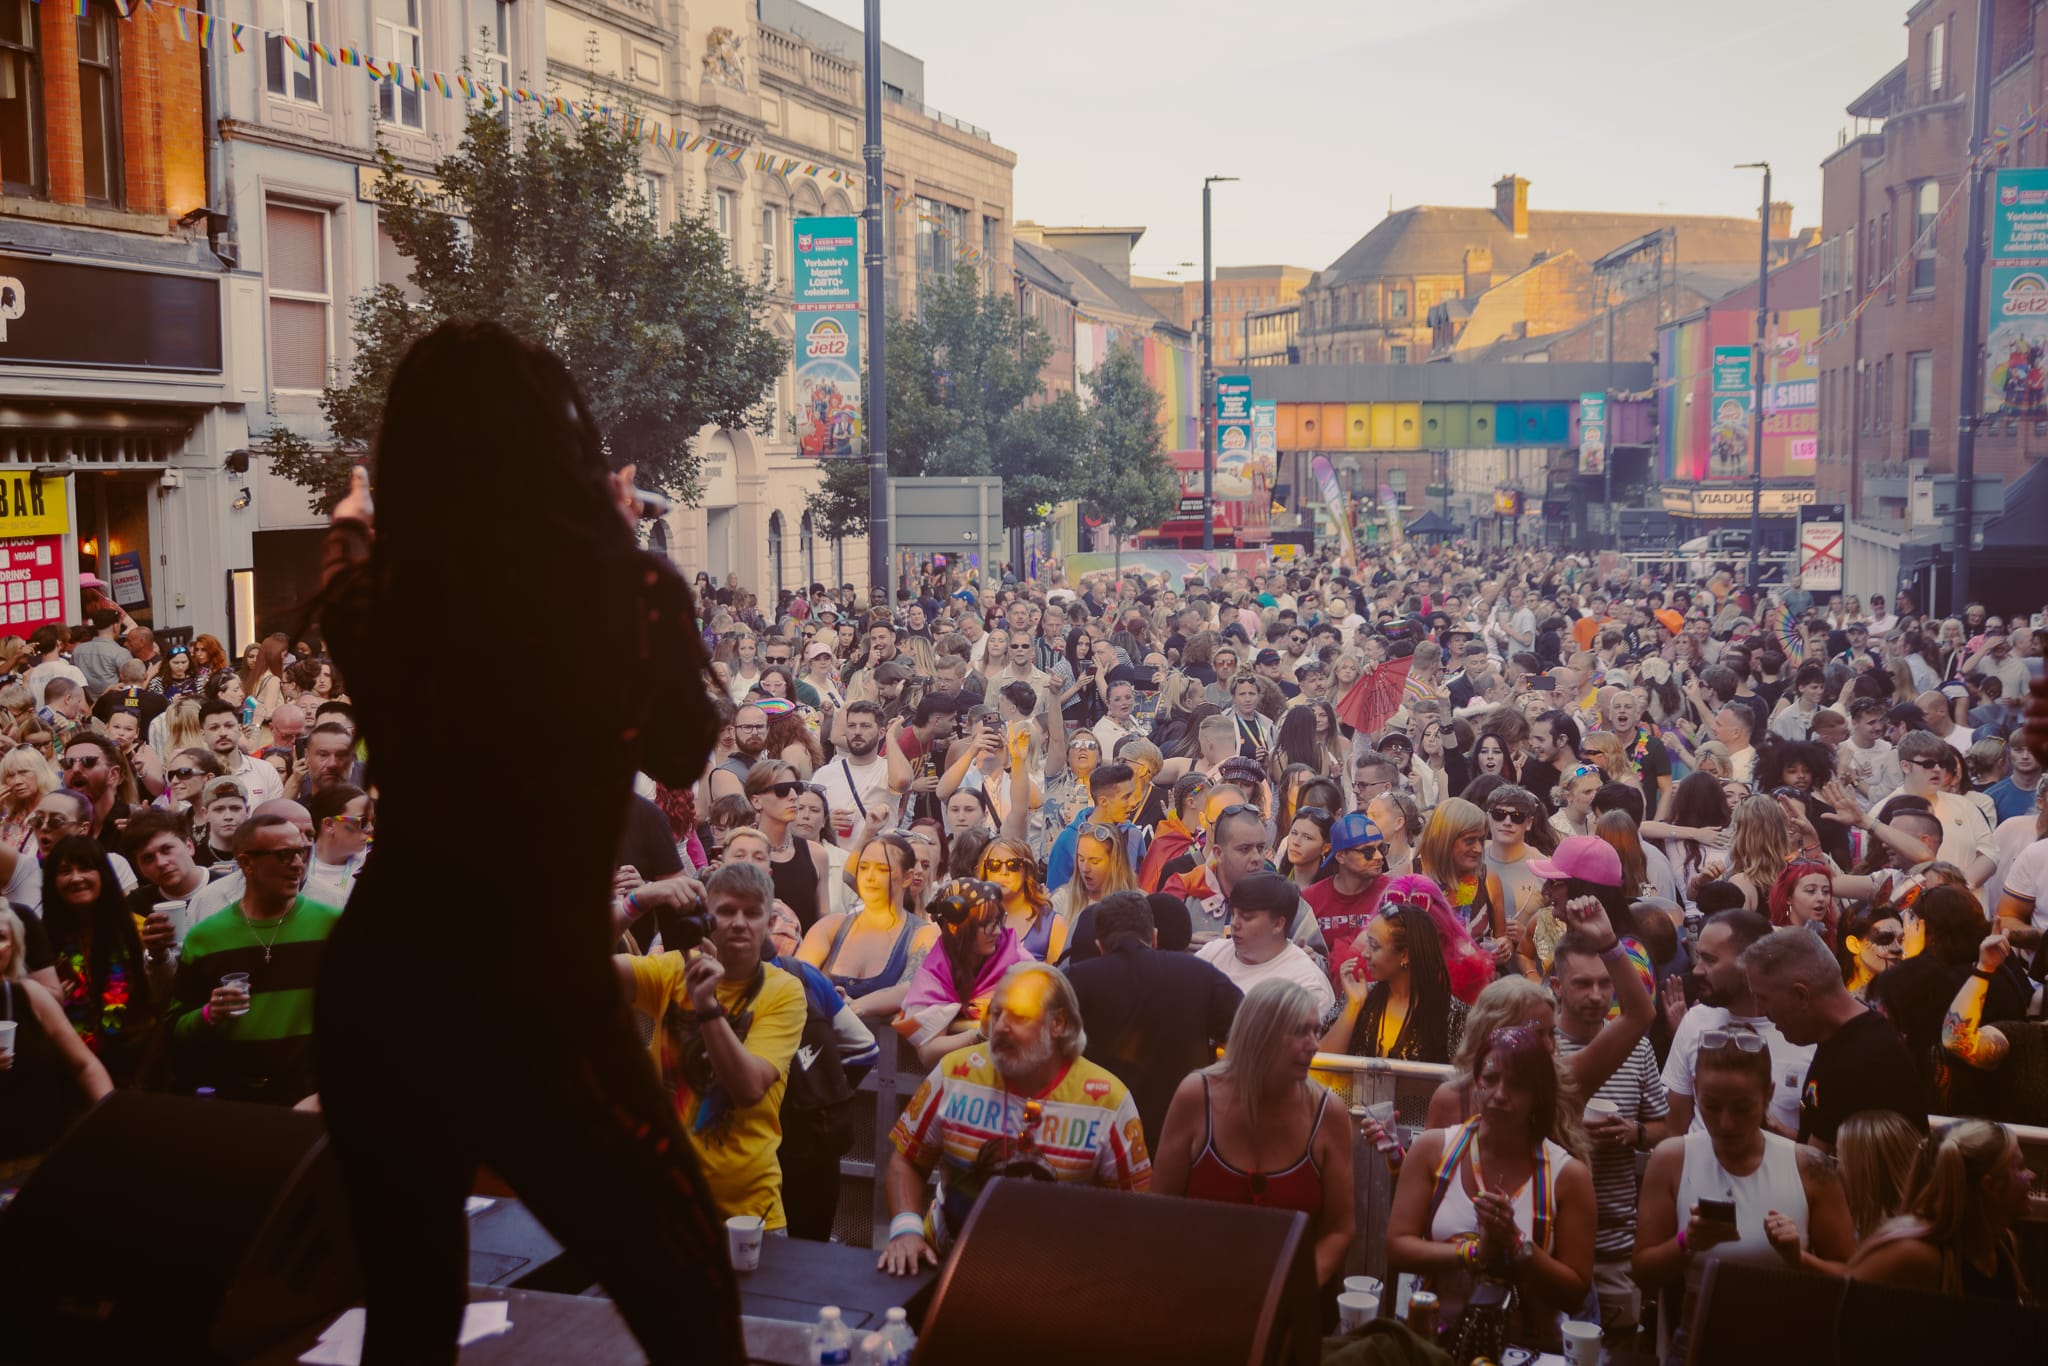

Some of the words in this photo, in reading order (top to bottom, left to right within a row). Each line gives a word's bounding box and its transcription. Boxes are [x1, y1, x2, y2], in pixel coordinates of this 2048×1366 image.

[803, 257, 849, 267] Yorkshire's
[810, 268, 842, 278] biggest
[809, 277, 844, 288] LGBTQ+
[803, 287, 850, 297] celebration
[809, 340, 845, 355] Jet2
[0, 478, 45, 517] BAR
[14, 551, 37, 562] VEGAN
[0, 568, 32, 582] DRINKS
[944, 1092, 1018, 1135] MORE
[1042, 1115, 1101, 1150] RIDE
